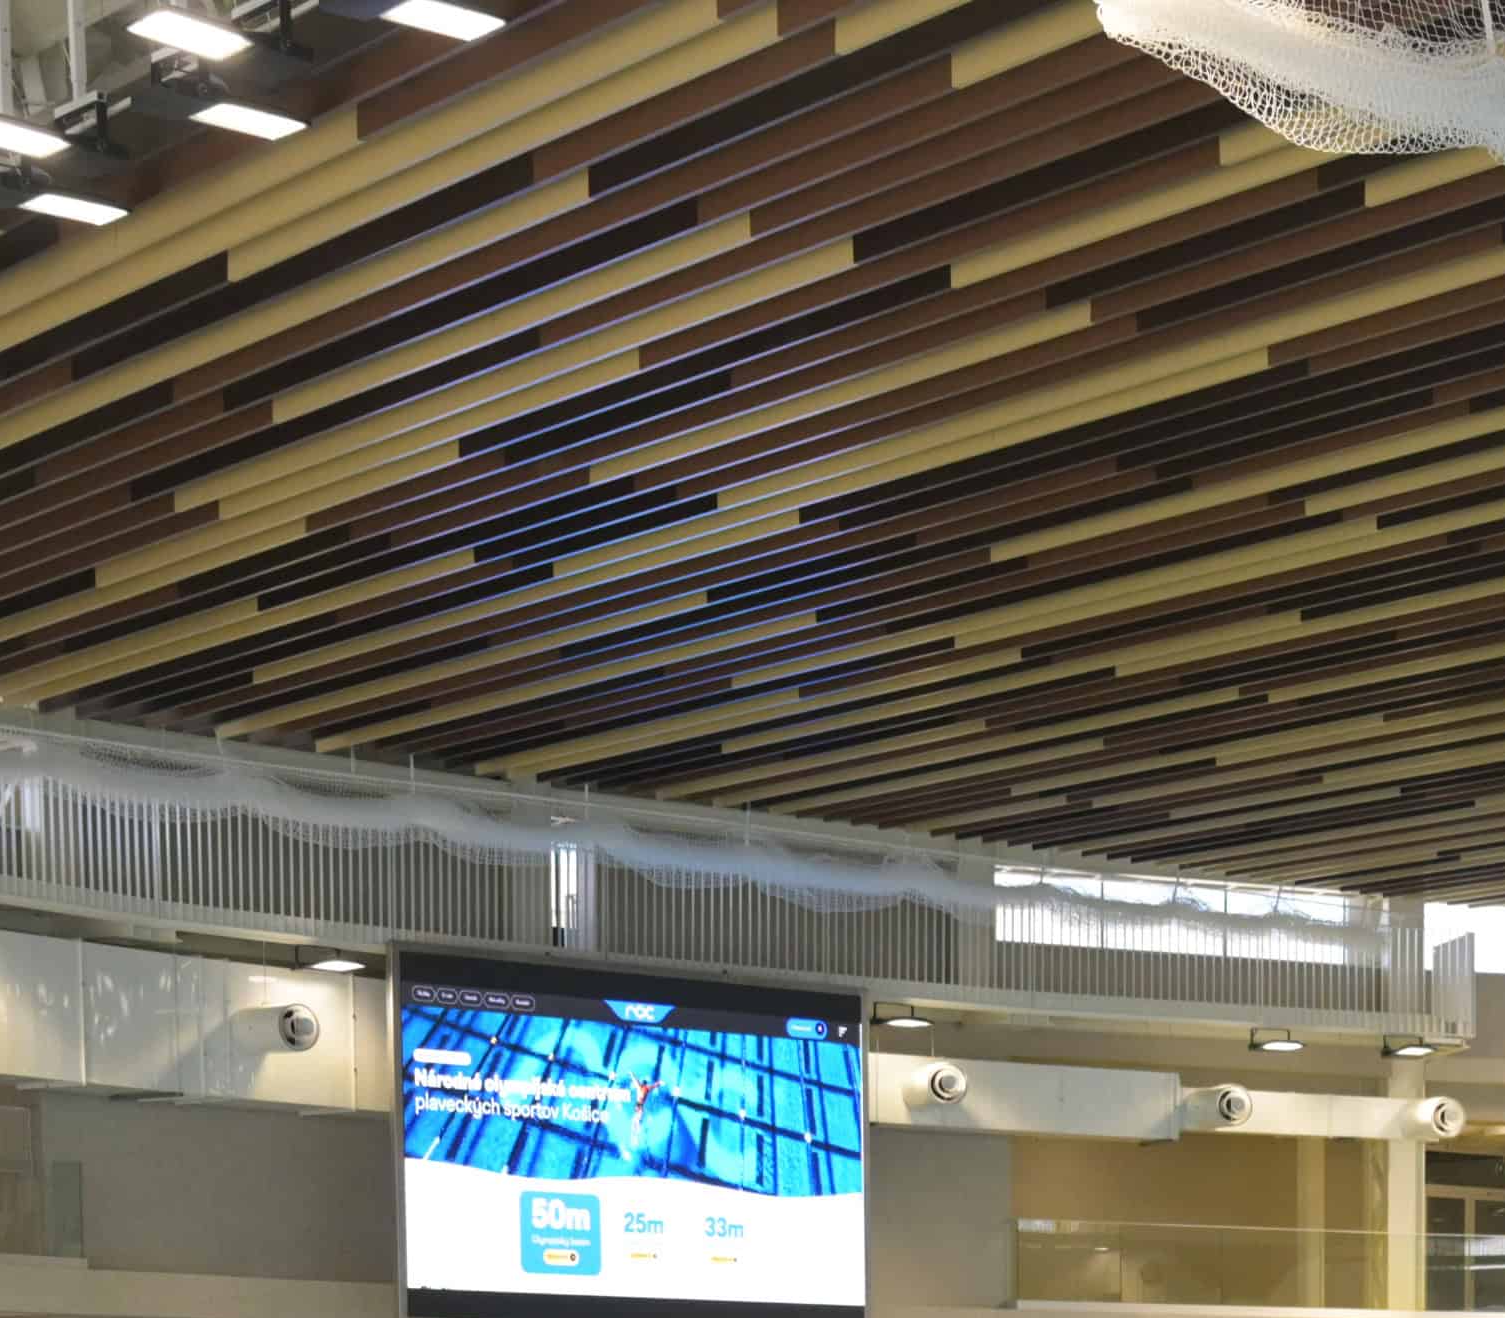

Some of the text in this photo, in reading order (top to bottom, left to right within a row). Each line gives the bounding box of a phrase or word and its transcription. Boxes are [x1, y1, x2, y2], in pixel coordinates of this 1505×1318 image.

[415, 1092, 501, 1119] plaveckých
[563, 1103, 610, 1123] Košice
[531, 1196, 592, 1231] 50m
[623, 1212, 664, 1235] 25m
[704, 1216, 744, 1239] 33m
